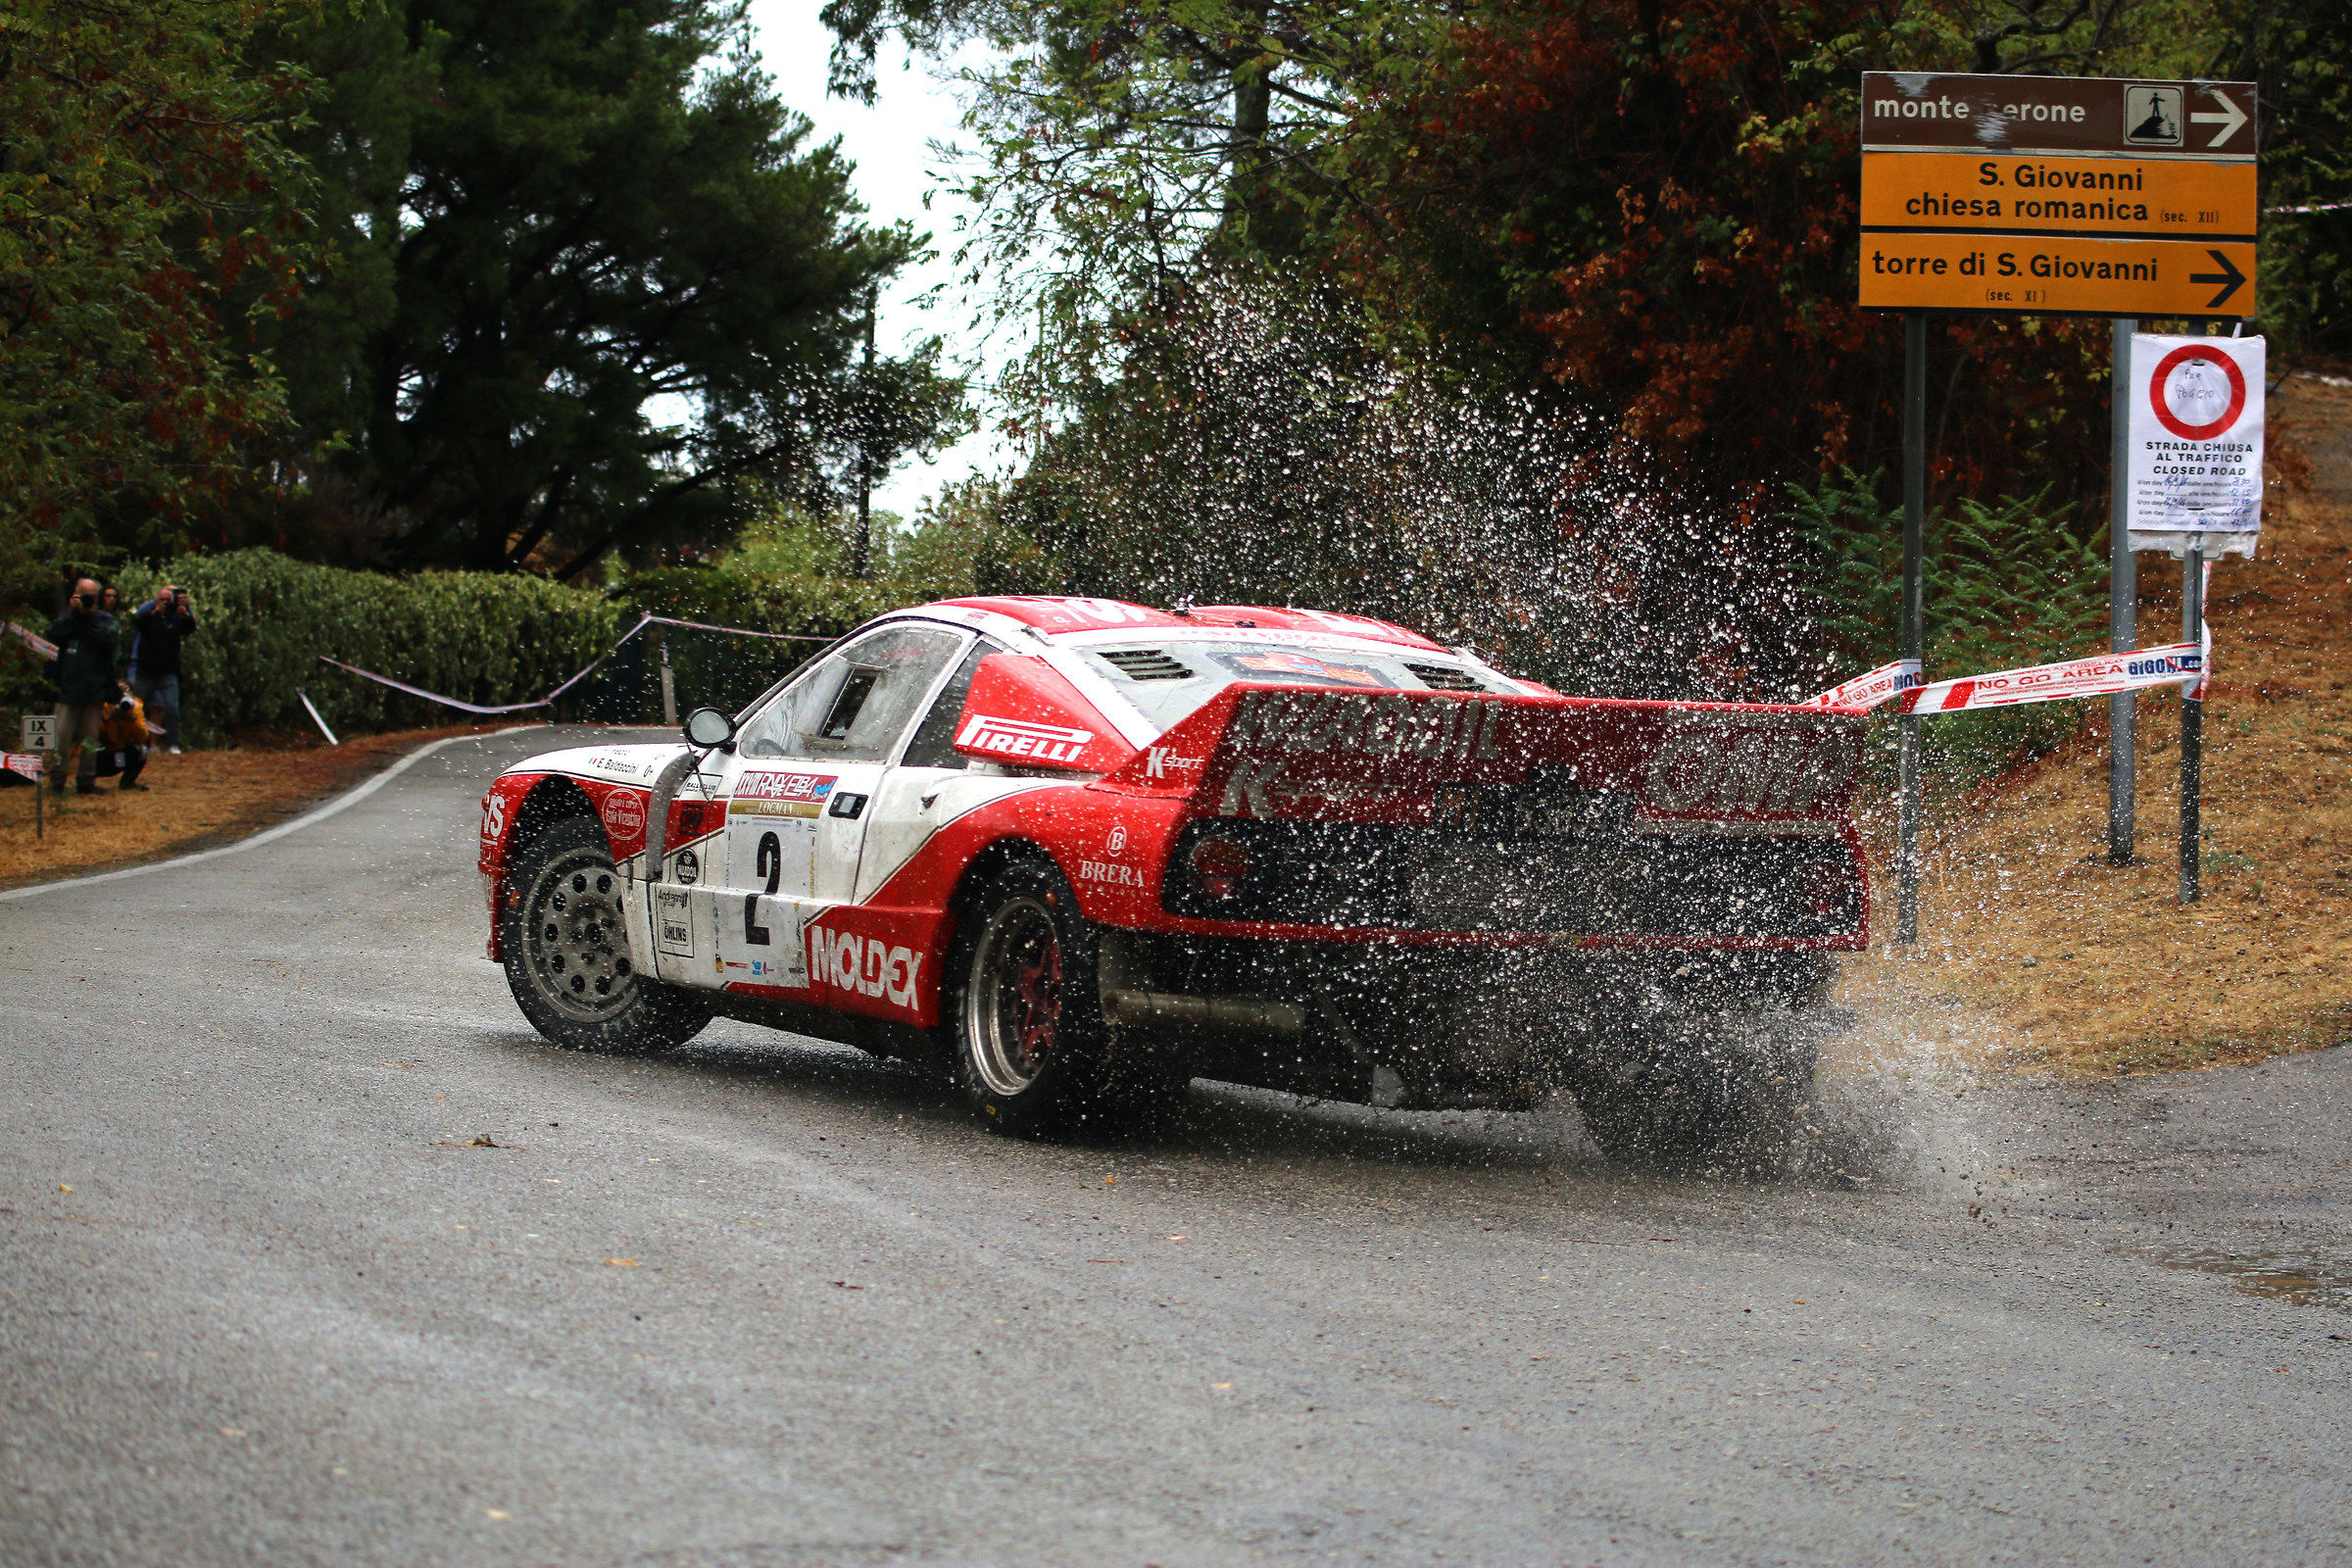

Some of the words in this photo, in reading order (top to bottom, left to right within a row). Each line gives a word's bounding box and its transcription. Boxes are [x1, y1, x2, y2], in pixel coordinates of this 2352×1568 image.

[1873, 95, 1970, 120] monte
[1986, 101, 2085, 122] erone
[1979, 163, 2005, 187] S.
[2014, 165, 2142, 191] Giovanni
[1905, 192, 2001, 217] chiesa
[2015, 197, 2149, 221] romanica
[2160, 210, 2187, 224] (sec.
[2198, 211, 2220, 224] XII)
[1872, 250, 1948, 275] torre
[1959, 252, 1985, 276] di
[1997, 253, 2023, 277] S.
[2030, 255, 2157, 282] Giovanni
[1985, 288, 2014, 304] (sec.
[2146, 441, 2198, 452] STRADA
[2203, 443, 2253, 453] CHIUSA
[2156, 453, 2173, 462] AL
[2179, 453, 2243, 463] TRAFFICO
[2153, 466, 2206, 475] CLOSED
[2210, 466, 2246, 476] ROAD
[1978, 678, 2009, 690] NO
[2019, 673, 2051, 685] GO
[2063, 663, 2125, 679] AREA
[1853, 688, 1868, 701] GO
[31, 720, 47, 732] IX
[955, 714, 1093, 763] PIRELLI
[34, 736, 45, 748] 4
[1078, 859, 1146, 888] BRERA
[744, 830, 782, 947] 2
[809, 925, 923, 1011] MOLDEX
